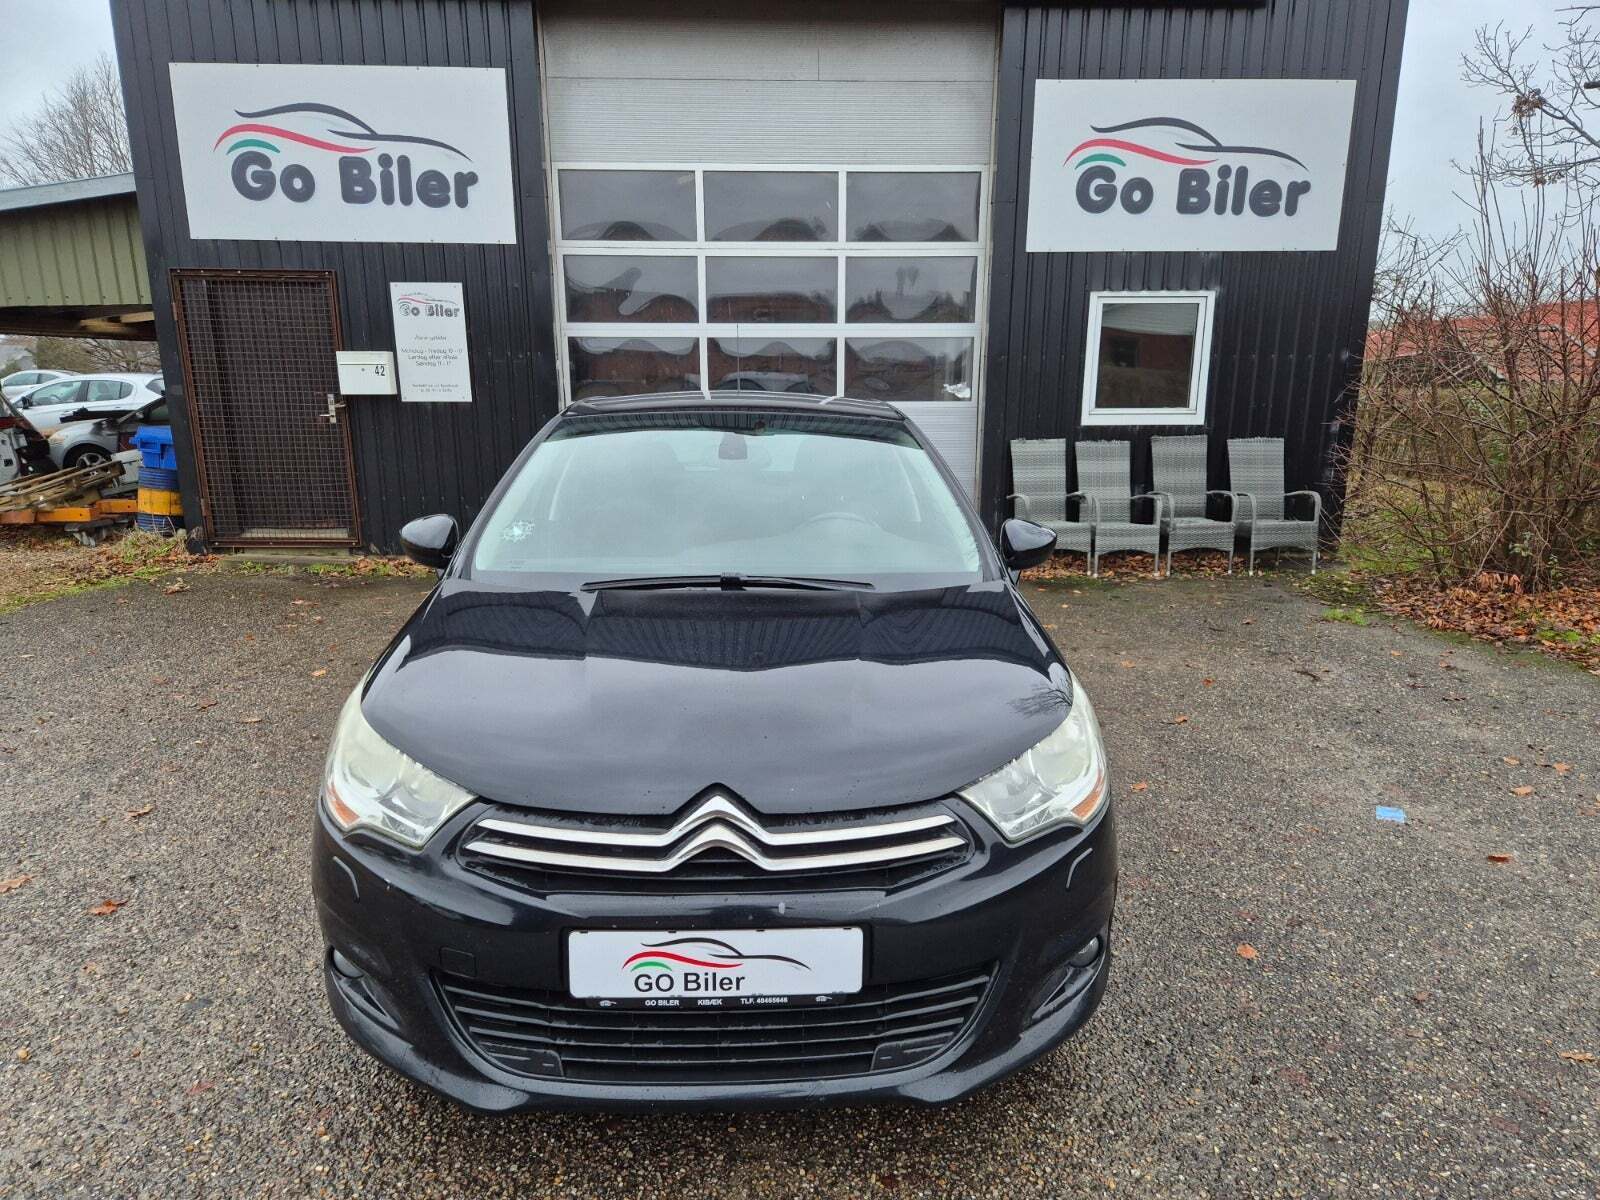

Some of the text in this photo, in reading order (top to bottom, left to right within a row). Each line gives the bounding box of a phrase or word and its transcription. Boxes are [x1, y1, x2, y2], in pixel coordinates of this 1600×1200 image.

[231, 150, 479, 209] Go Biler
[1075, 163, 1311, 218] Go Biler
[425, 303, 460, 318] Biler
[375, 365, 386, 376] 42
[634, 972, 746, 992] GO Biler
